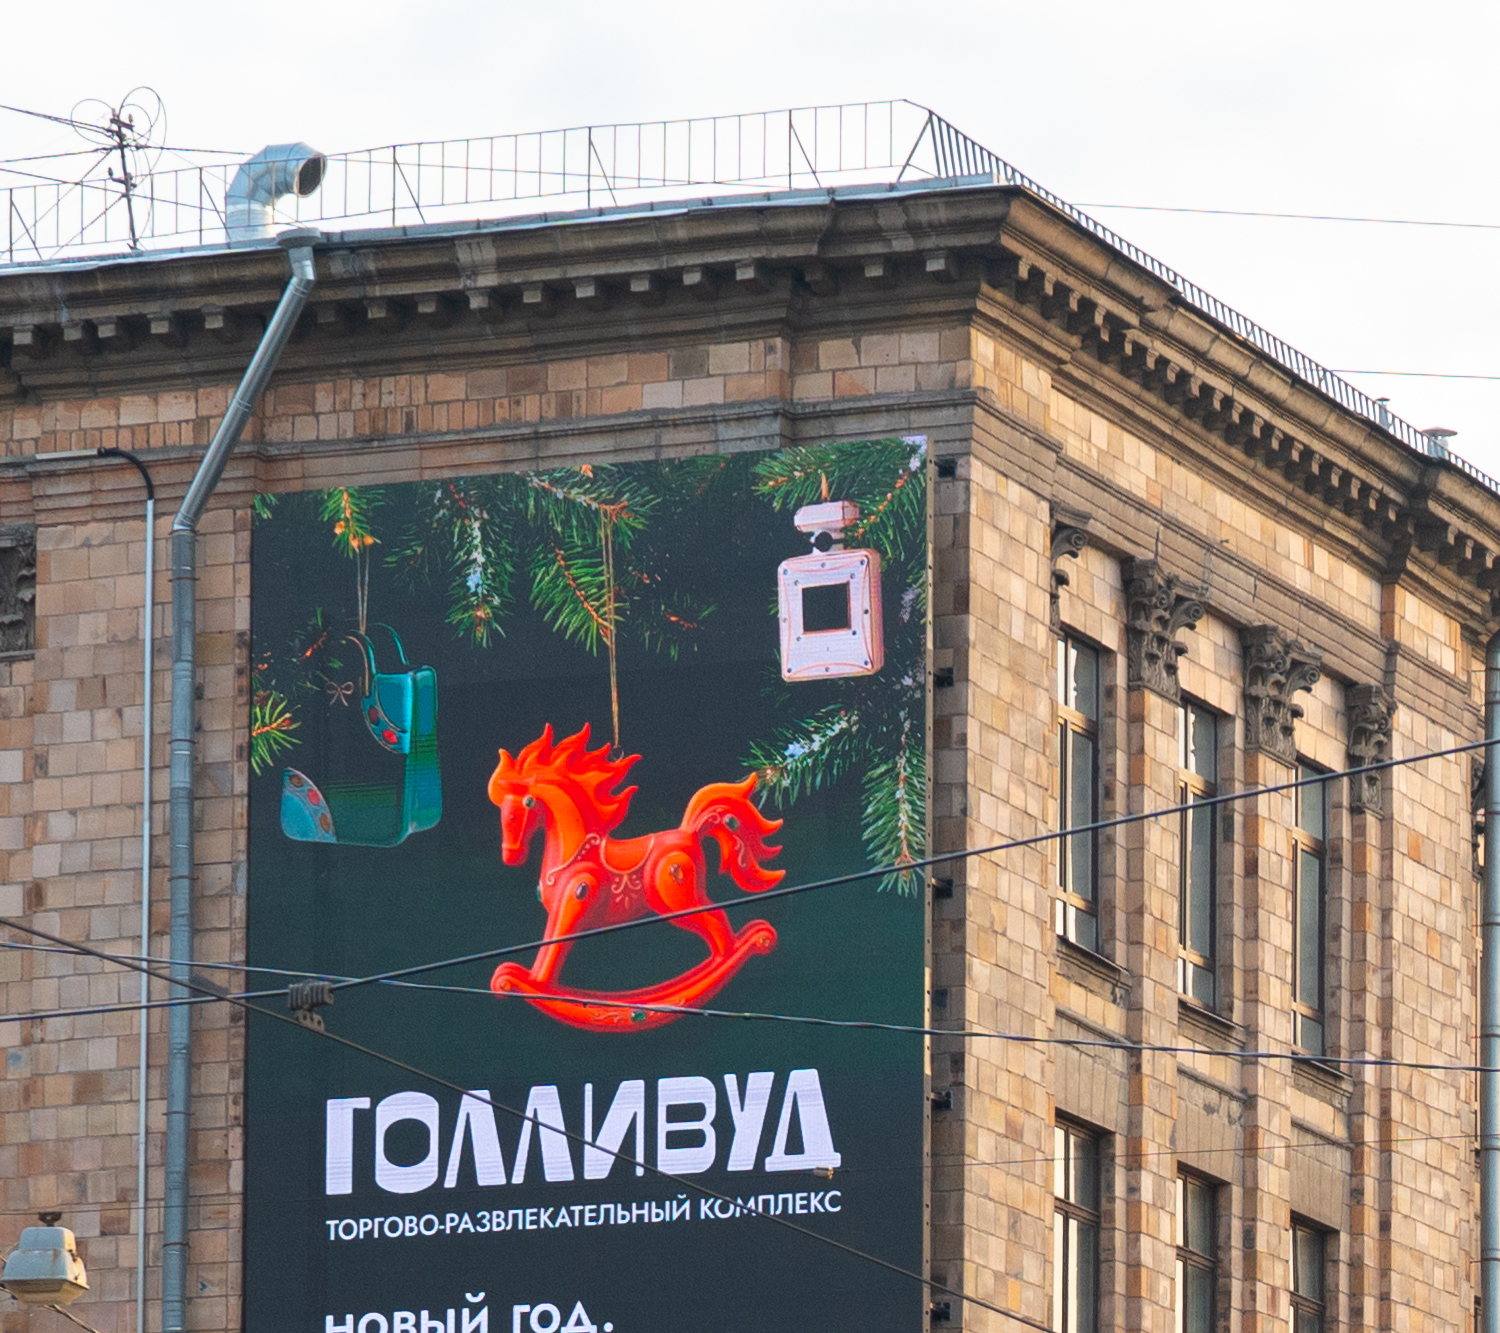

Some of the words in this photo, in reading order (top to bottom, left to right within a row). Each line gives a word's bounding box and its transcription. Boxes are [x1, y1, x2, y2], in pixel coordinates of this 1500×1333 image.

[325, 1068, 842, 1195] ГОЛЛИВУД
[326, 1194, 691, 1241] ТОРГОВО-РАЗВЛЕКАТЕЛЬНЫЙ
[699, 1191, 842, 1220] КОМПЛЕКС
